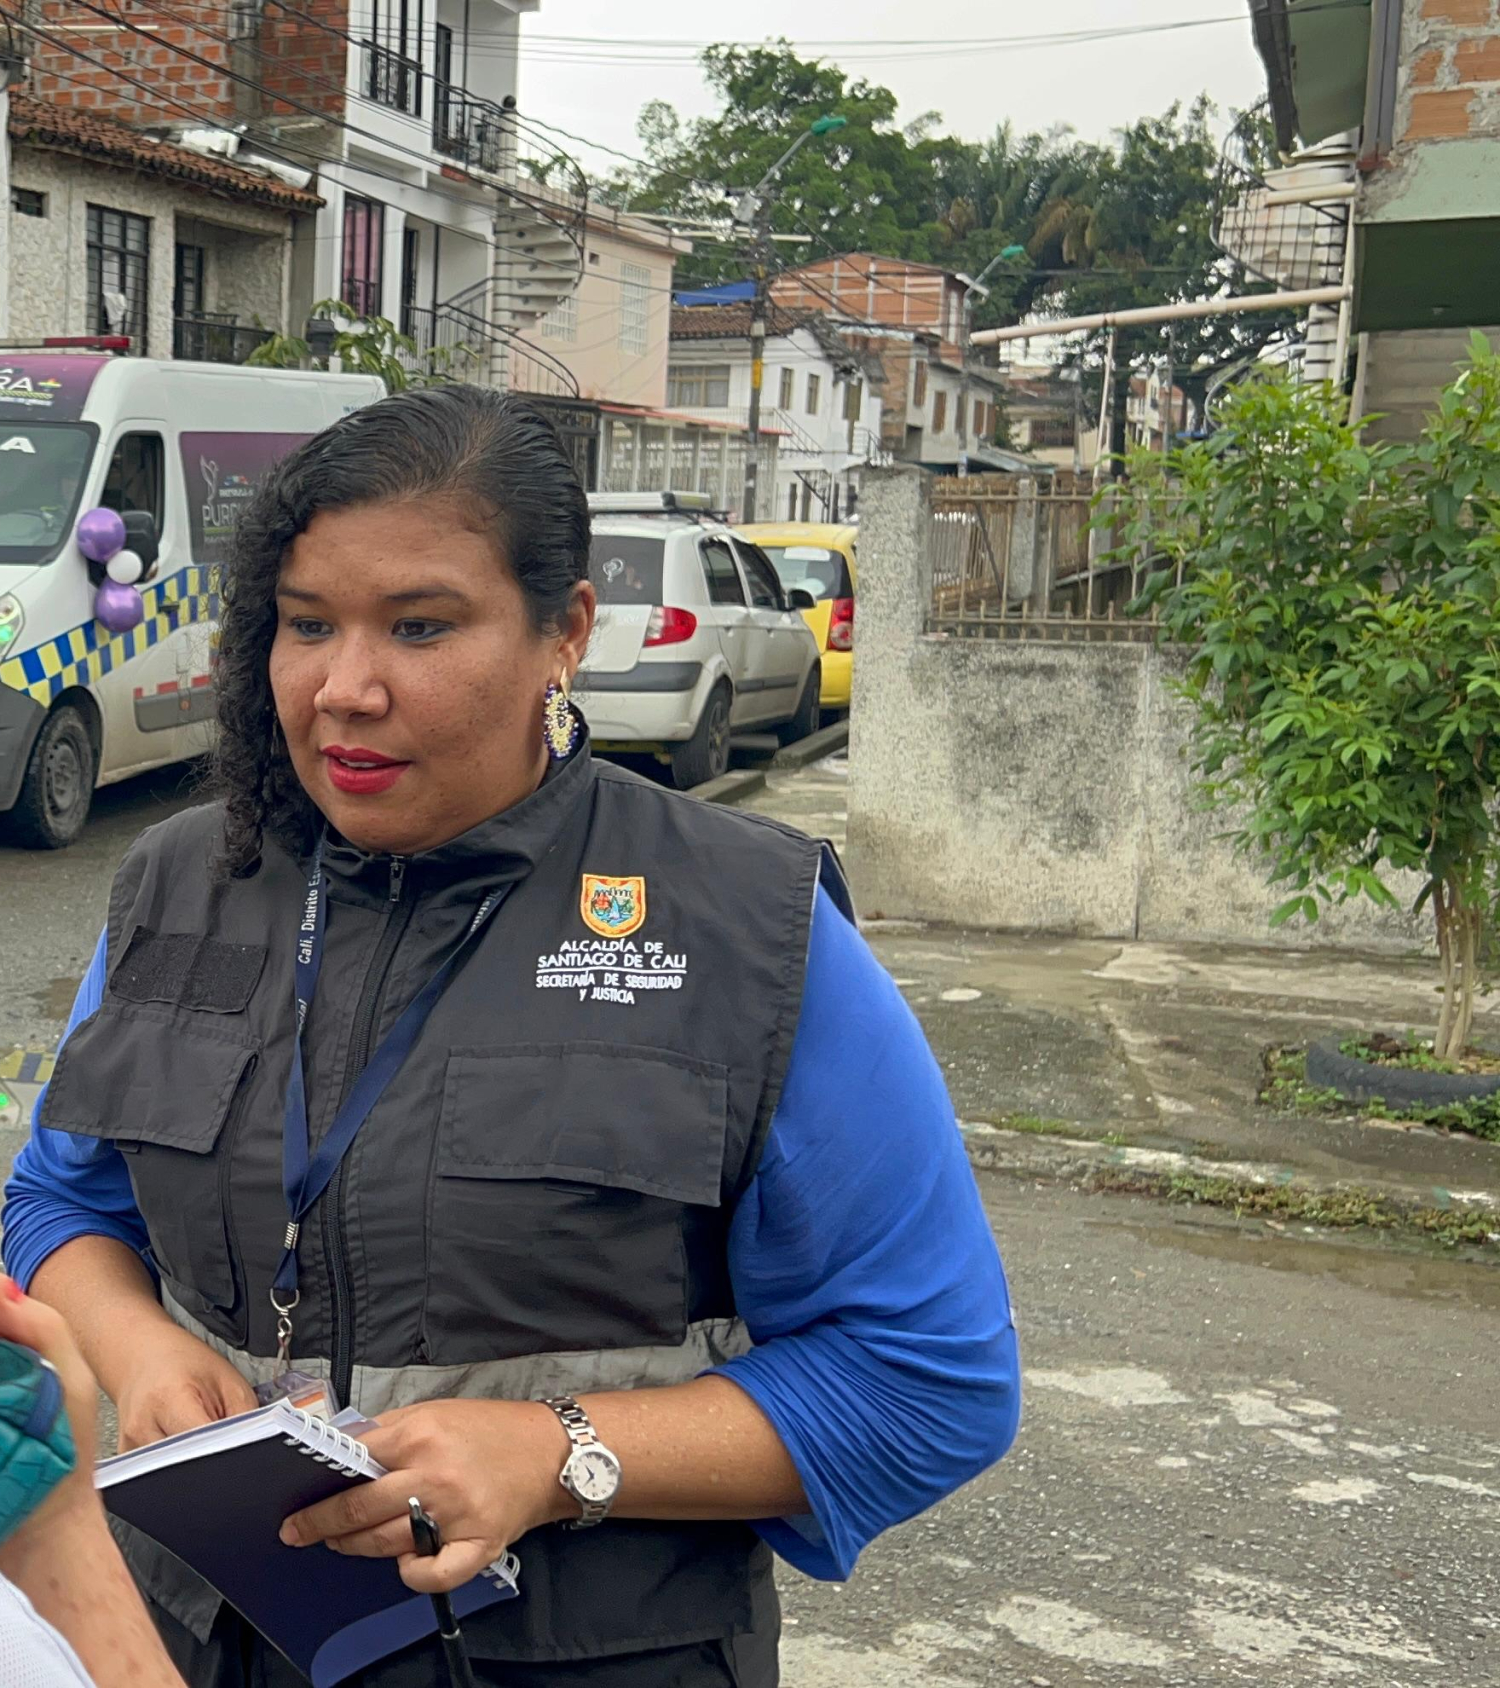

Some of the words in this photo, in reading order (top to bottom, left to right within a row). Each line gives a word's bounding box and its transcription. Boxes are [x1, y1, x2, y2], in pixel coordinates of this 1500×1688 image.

[301, 889, 318, 932] Distrito
[298, 935, 316, 965] Cali,
[560, 938, 638, 953] ALCALDÍA
[644, 942, 664, 954] DE
[537, 952, 618, 968] SANTIAGO
[623, 954, 644, 968] DE
[650, 954, 687, 969] CALI
[604, 973, 620, 986] DE
[625, 974, 683, 990] SEGURIDAD
[591, 987, 636, 1005] JUSTICIA
